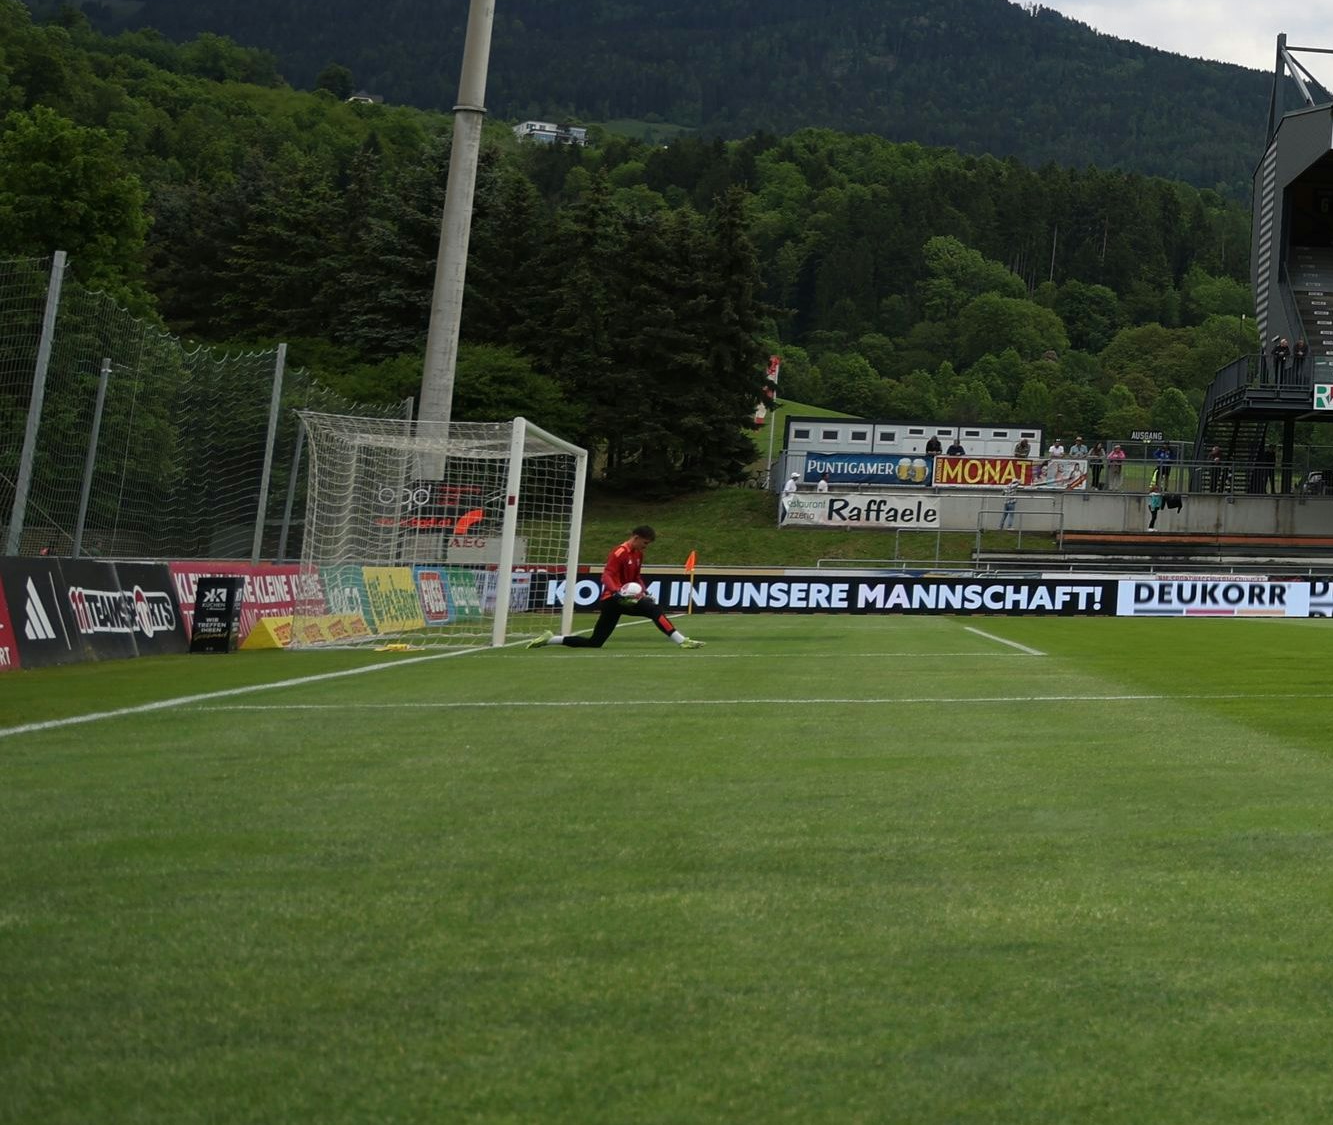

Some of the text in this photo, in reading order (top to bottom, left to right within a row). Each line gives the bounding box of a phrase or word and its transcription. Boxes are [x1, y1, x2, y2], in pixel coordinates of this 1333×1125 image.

[807, 459, 894, 475] PUNTIGAMER
[942, 459, 1032, 484] MONAT
[787, 499, 826, 508] estaurant
[828, 498, 937, 523] Raffaele
[786, 511, 815, 520] izzeria
[449, 537, 486, 548] AEG
[254, 575, 291, 603] KLEINE
[546, 581, 661, 606] KO
[670, 582, 707, 607] IN
[716, 582, 849, 608] UNSERE
[857, 583, 1102, 610] MANNSCHAFT!
[1134, 582, 1287, 605] DEUKORR
